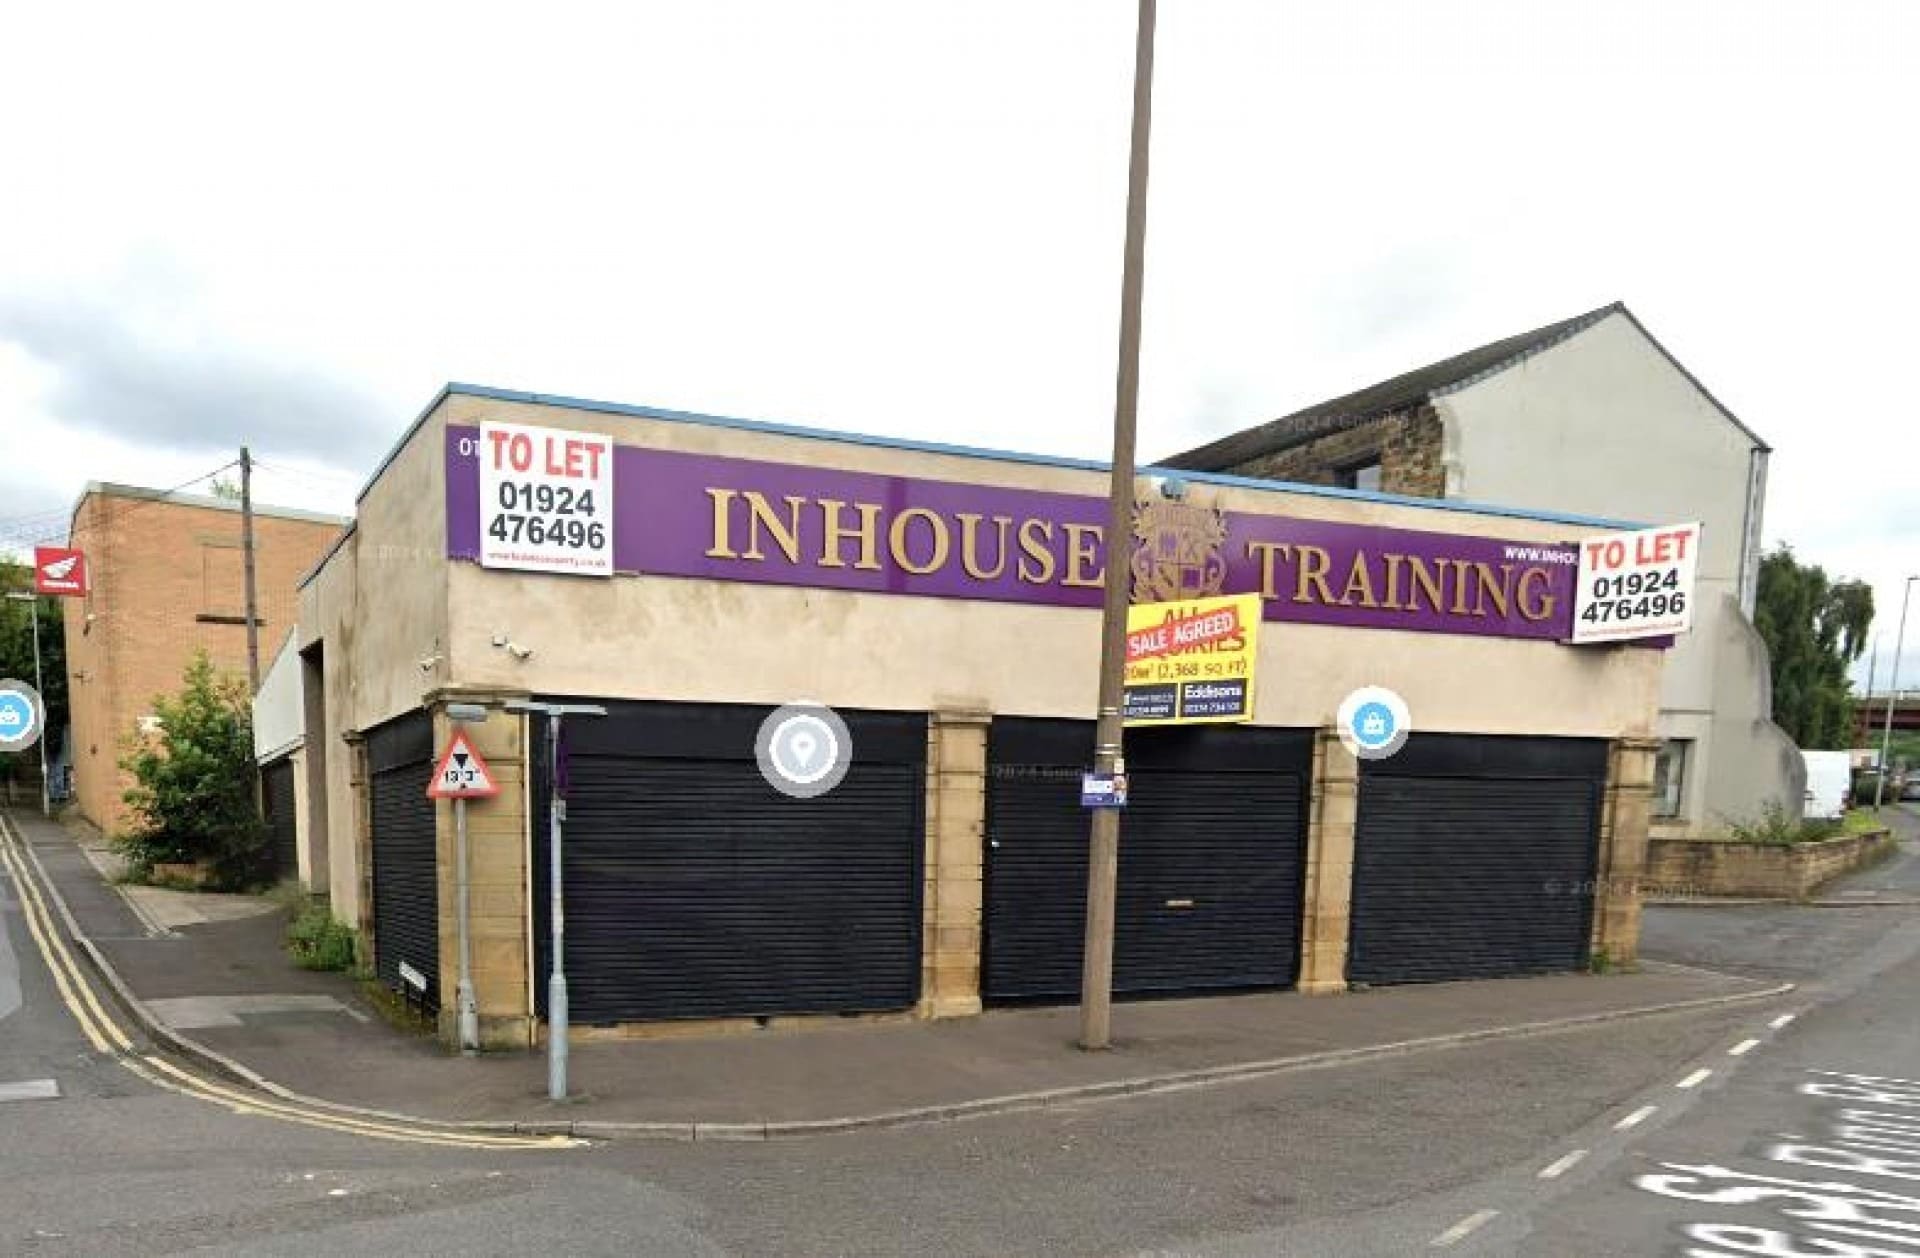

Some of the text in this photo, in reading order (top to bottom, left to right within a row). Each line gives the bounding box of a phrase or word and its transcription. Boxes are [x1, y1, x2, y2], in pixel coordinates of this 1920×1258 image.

[487, 431, 605, 481] TO LET
[500, 481, 595, 517] 01924
[489, 514, 605, 549] 476496
[705, 487, 1554, 621] INHOUSE TRAINING
[1587, 531, 1692, 571] TO LET
[1594, 568, 1678, 599] 01924
[1581, 592, 1686, 624] 476496
[1127, 629, 1168, 656] SALE
[1174, 611, 1233, 645] AGREED
